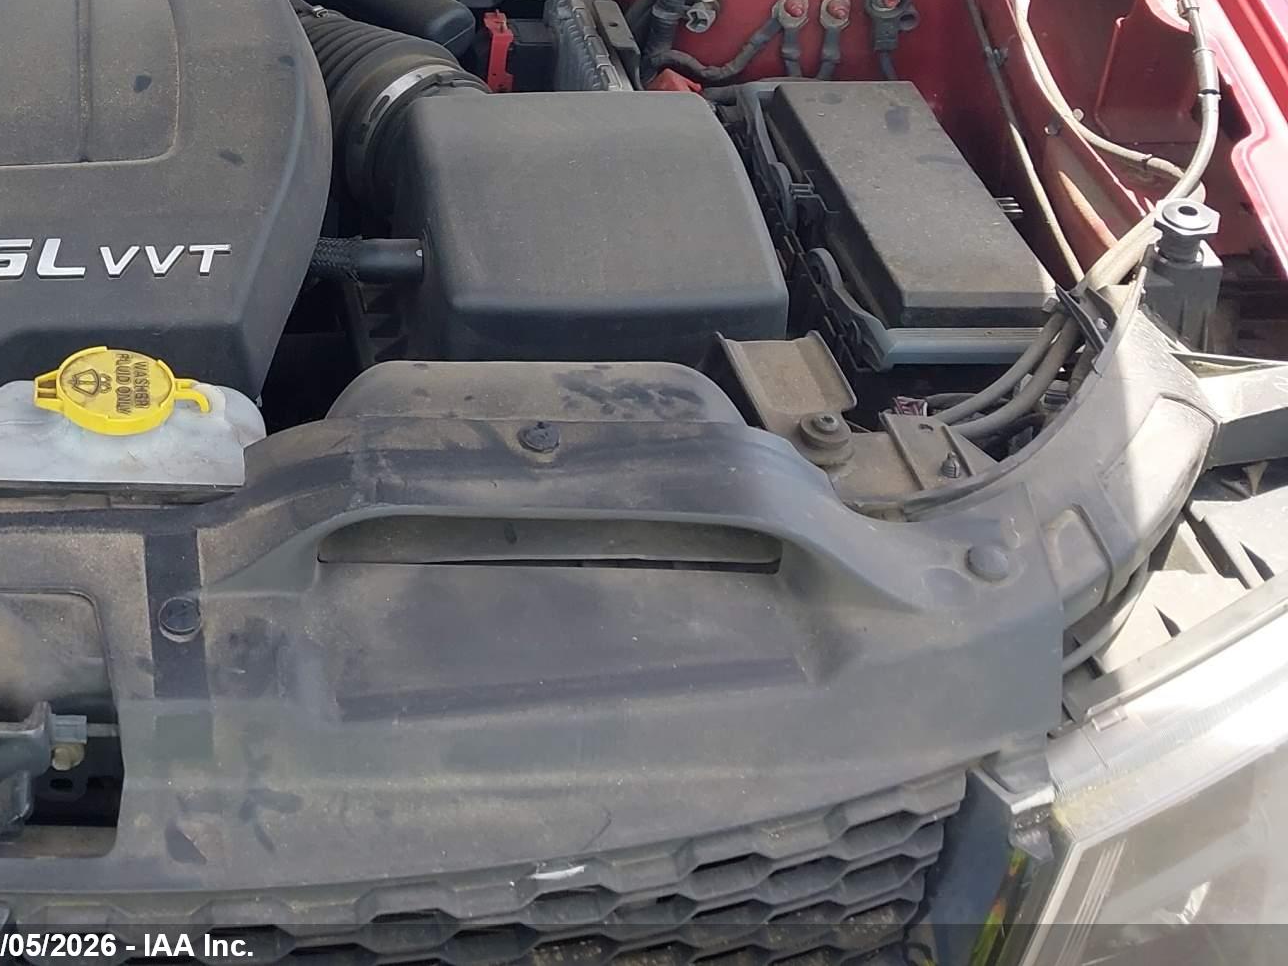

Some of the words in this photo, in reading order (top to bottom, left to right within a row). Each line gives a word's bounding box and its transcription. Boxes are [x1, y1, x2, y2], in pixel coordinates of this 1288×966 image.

[99, 243, 232, 279] VVT
[115, 353, 131, 384] FLUID
[134, 361, 150, 409] WASHER
[115, 386, 131, 415] ONLY
